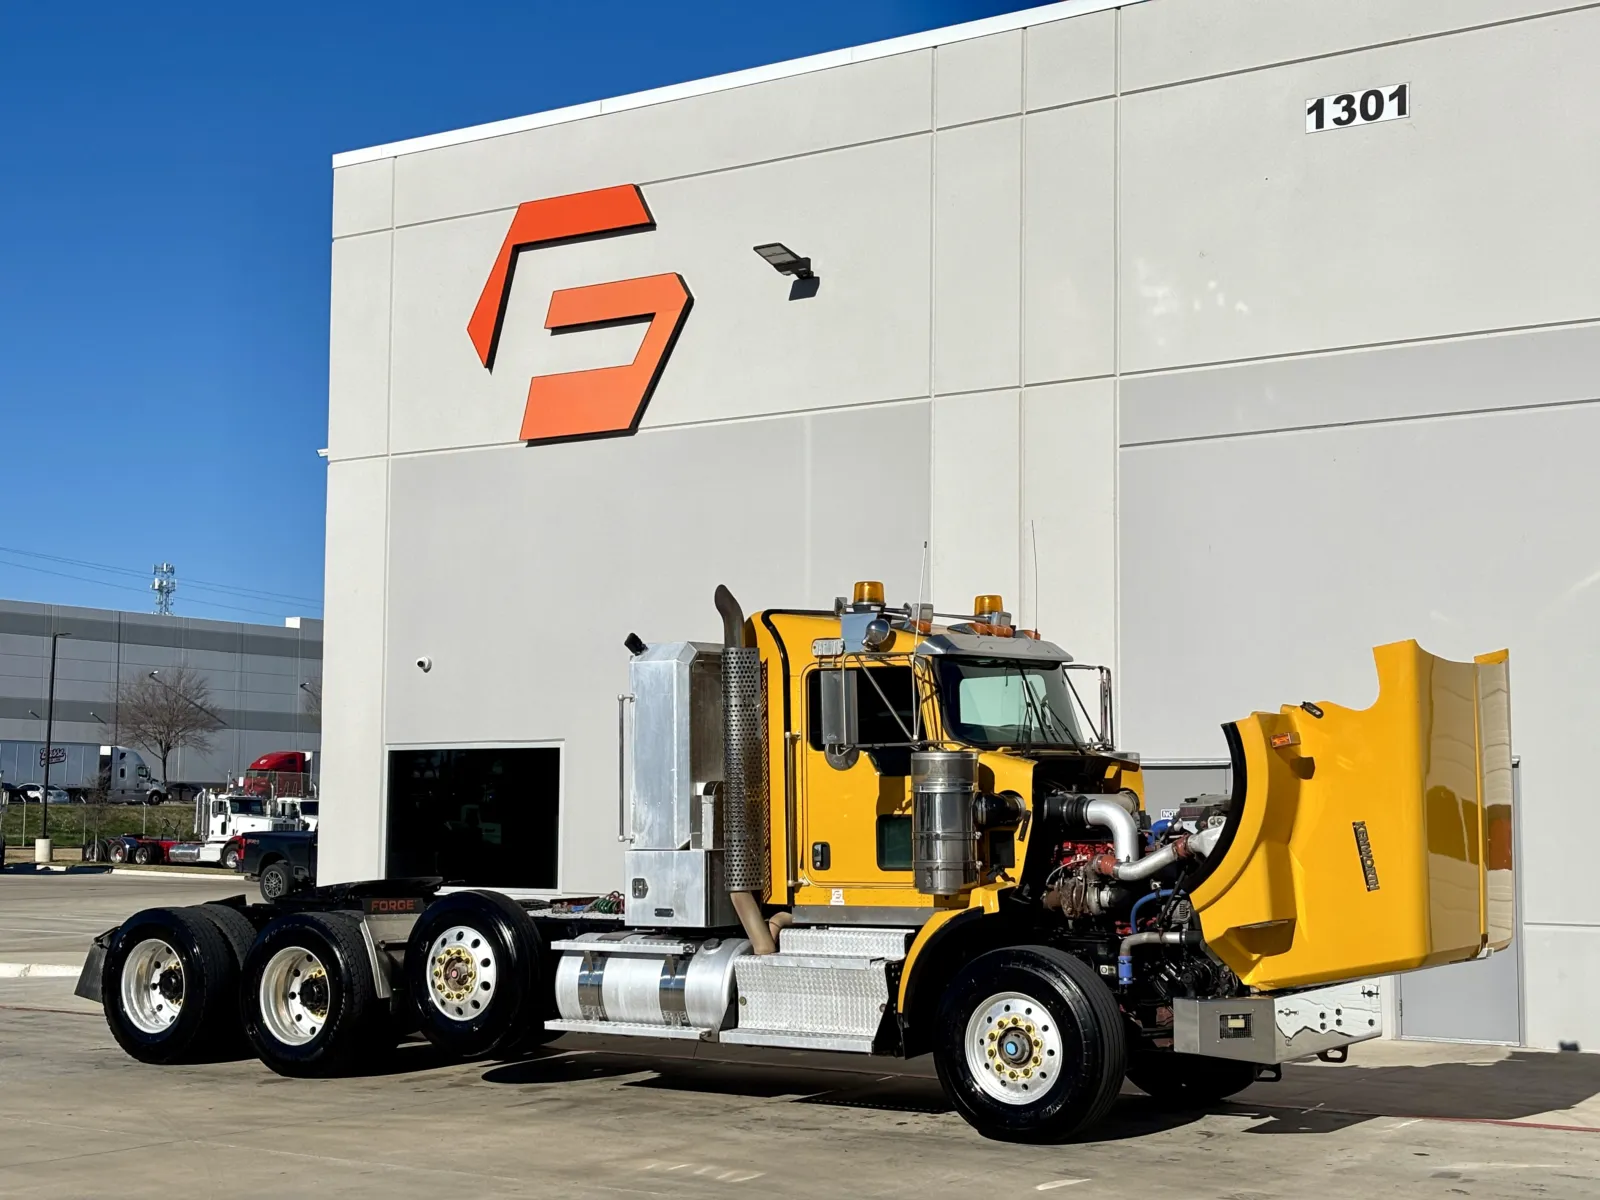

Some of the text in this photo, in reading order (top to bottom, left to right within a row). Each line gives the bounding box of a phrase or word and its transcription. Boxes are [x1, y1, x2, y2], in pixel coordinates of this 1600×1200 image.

[1307, 84, 1407, 130] 1301
[1352, 821, 1380, 892] KENWORTH
[371, 900, 415, 911] FORGE
